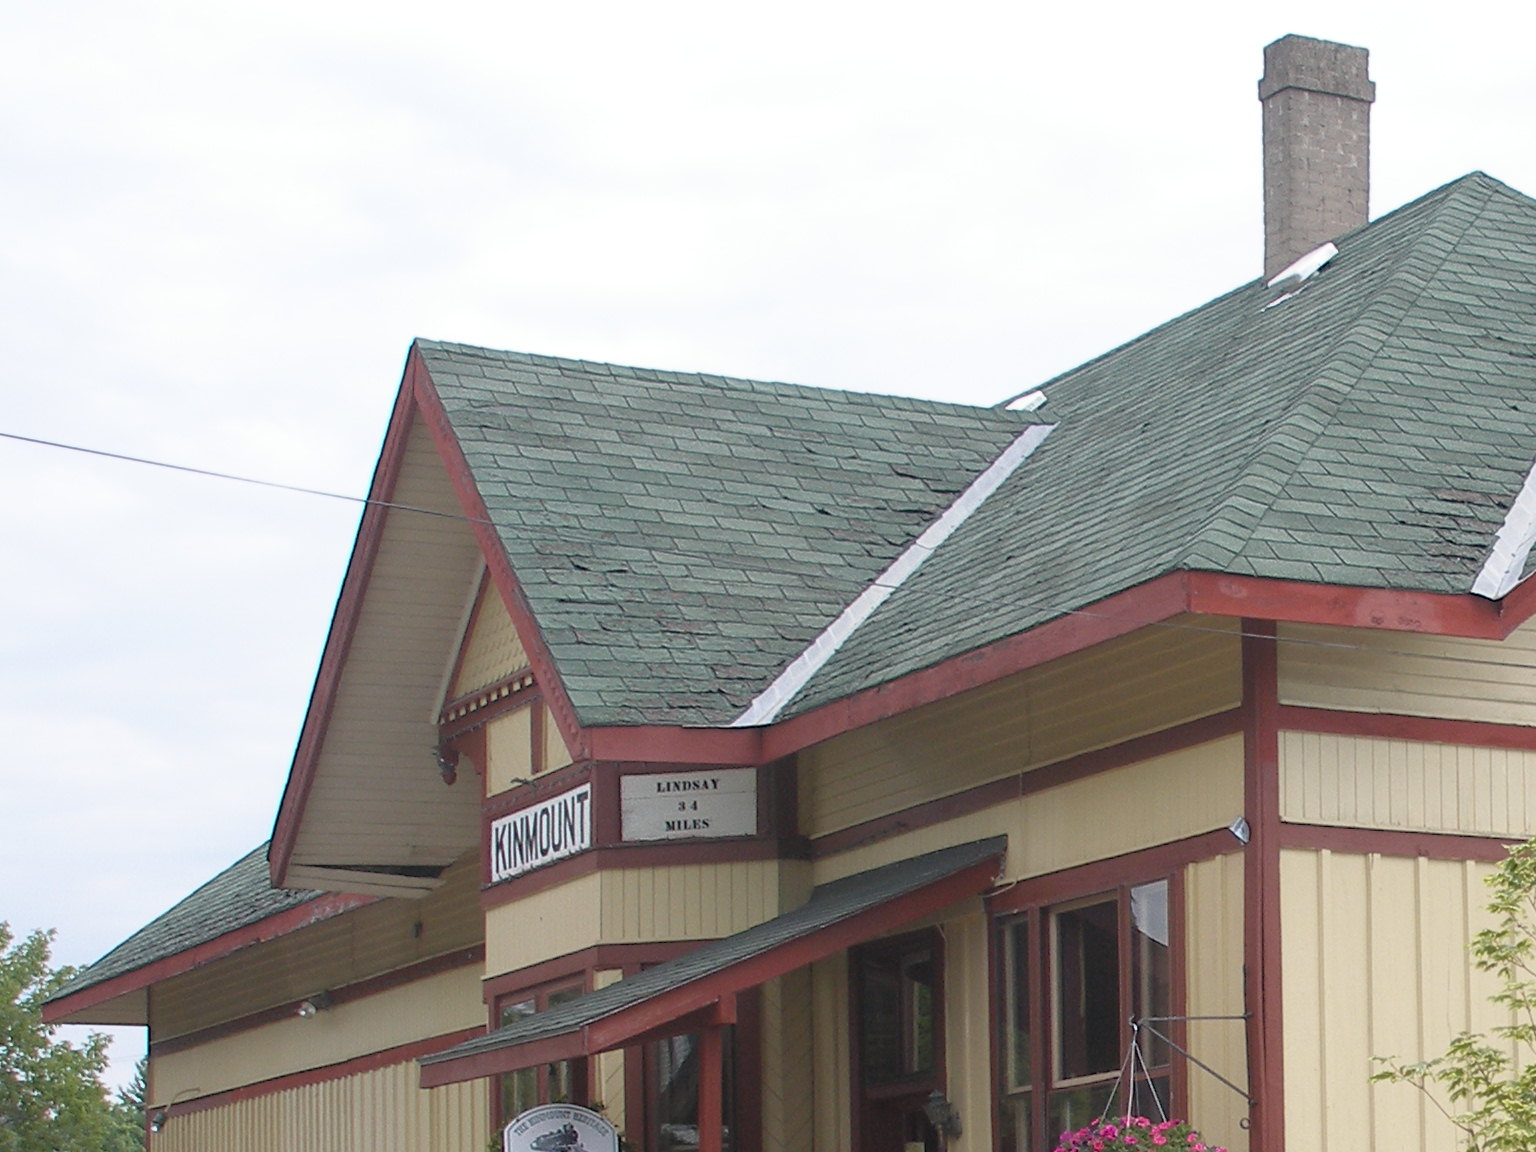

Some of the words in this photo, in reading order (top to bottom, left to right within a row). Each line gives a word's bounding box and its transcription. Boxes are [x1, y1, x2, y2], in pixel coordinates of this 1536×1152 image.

[656, 778, 719, 794] LINDSAY
[494, 791, 589, 874] KINMOUNT
[665, 818, 710, 832] MILES
